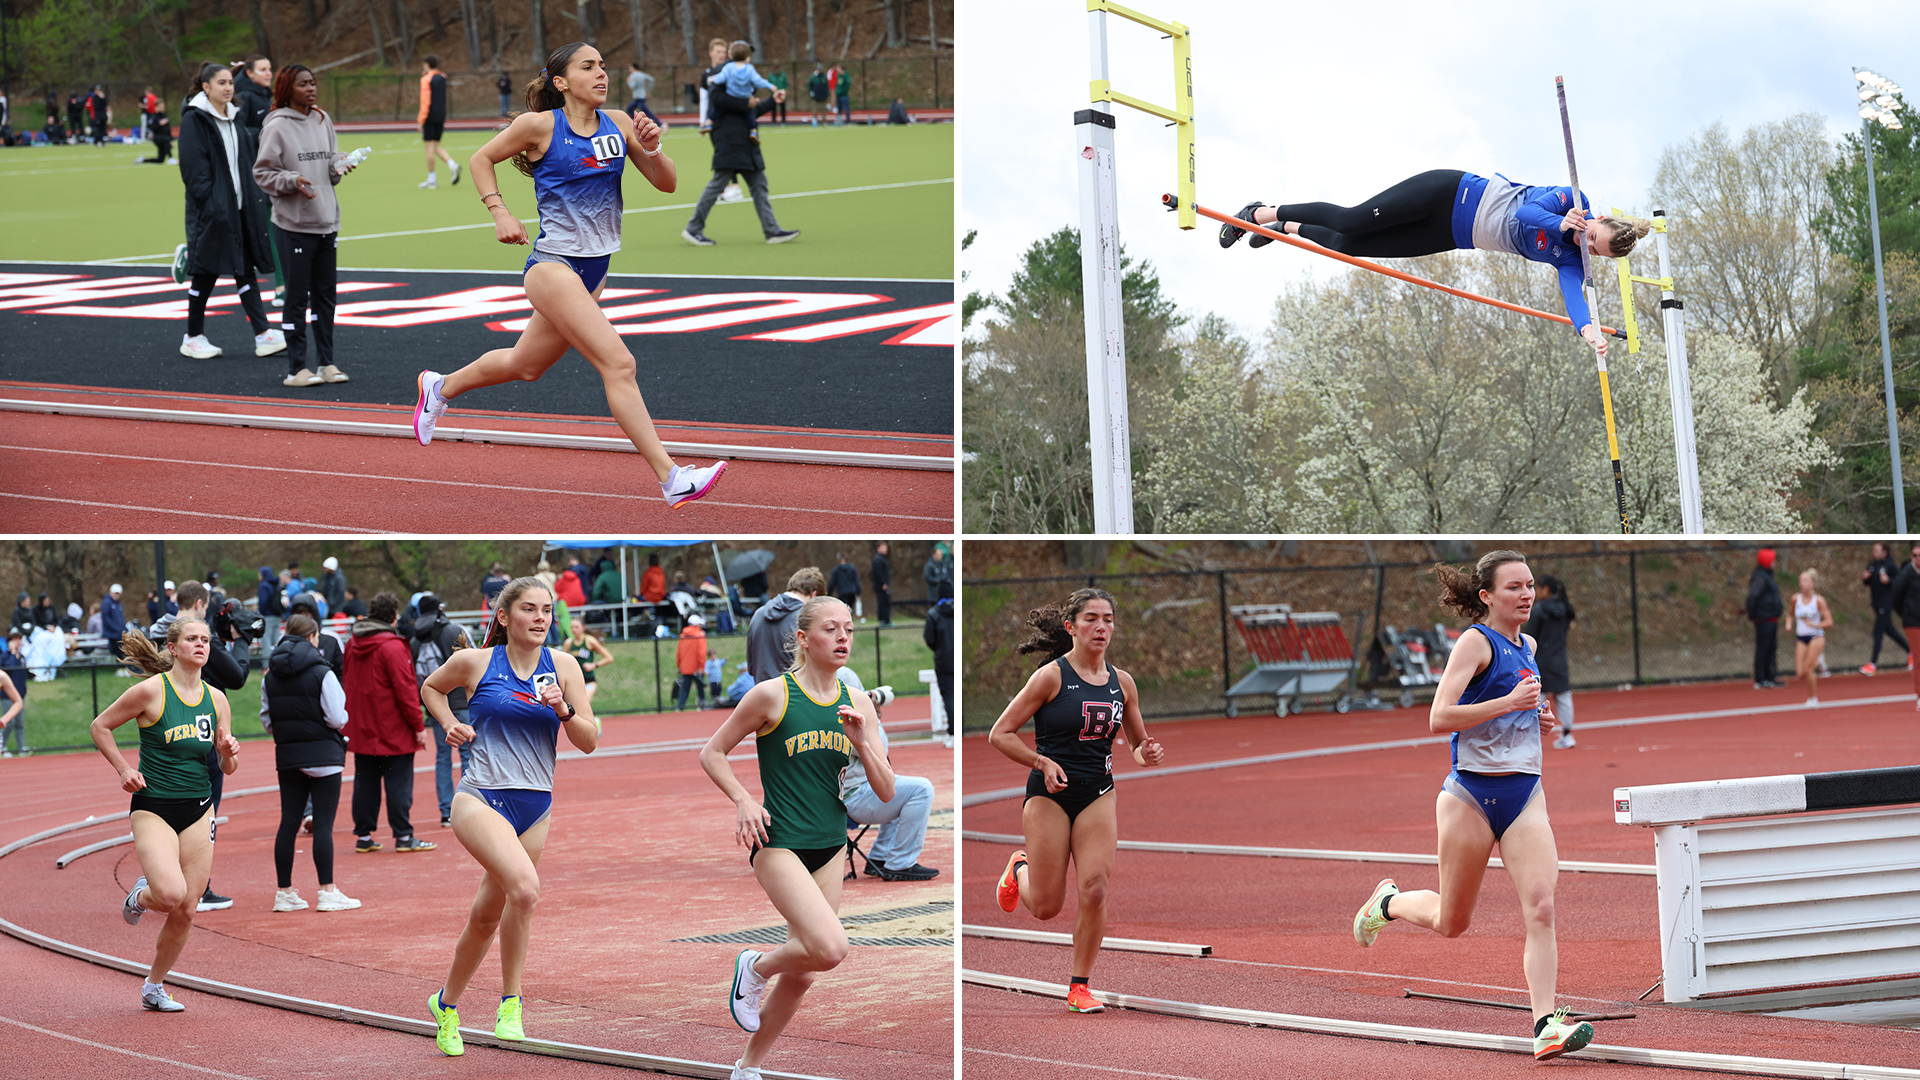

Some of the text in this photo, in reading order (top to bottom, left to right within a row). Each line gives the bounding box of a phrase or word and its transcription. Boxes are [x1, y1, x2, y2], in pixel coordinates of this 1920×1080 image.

[1185, 57, 1193, 98] UCS
[595, 135, 620, 158] 10
[198, 718, 211, 739] 9
[1079, 701, 1114, 741] B
[164, 723, 214, 744] VERM
